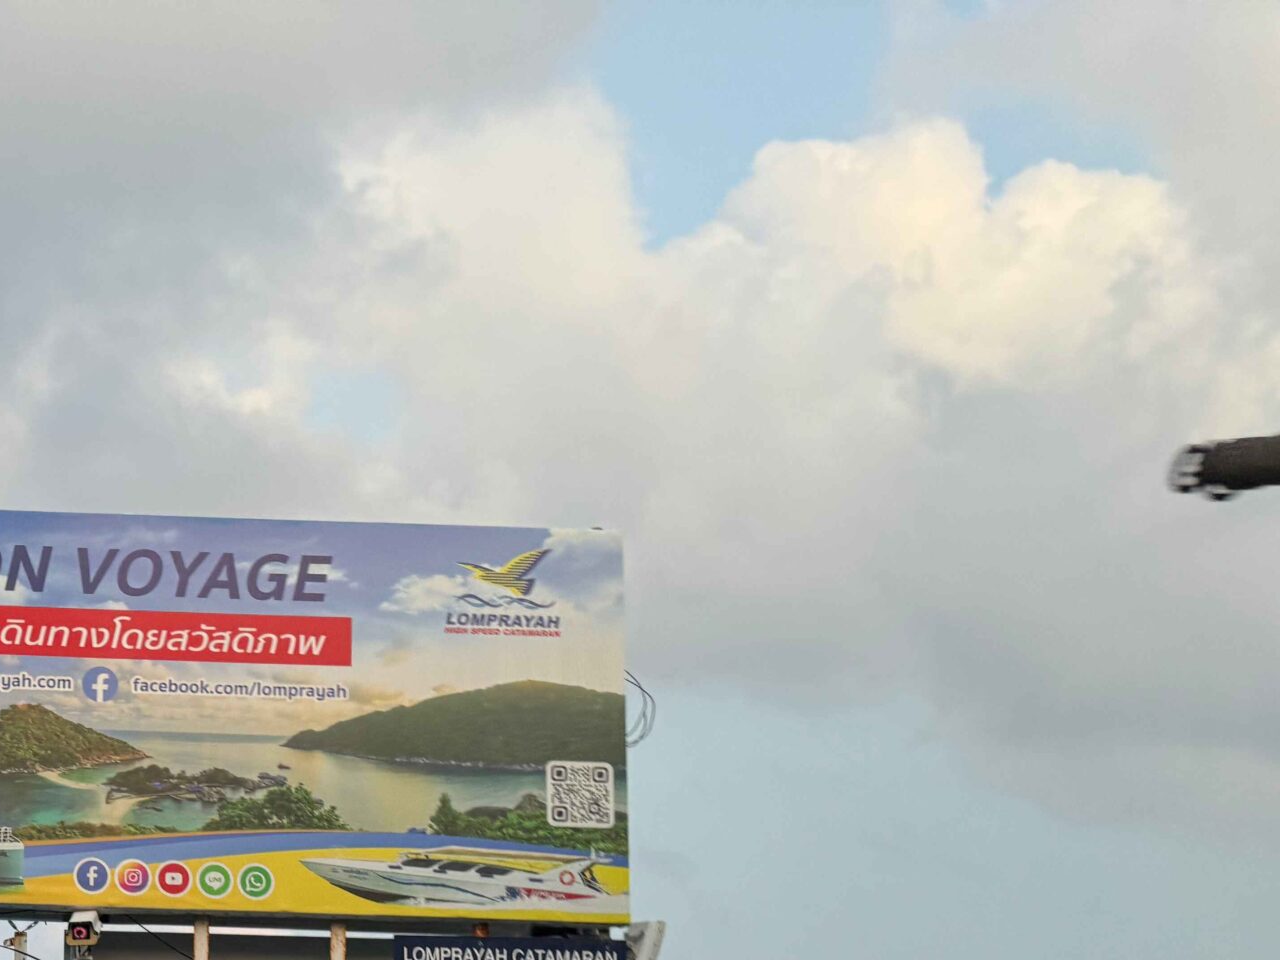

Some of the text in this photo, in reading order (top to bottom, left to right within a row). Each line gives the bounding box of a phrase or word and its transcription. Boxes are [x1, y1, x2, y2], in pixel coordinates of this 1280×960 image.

[76, 546, 334, 602] VOYAGE
[445, 612, 561, 628] LOMPRAYAH
[133, 677, 348, 700] facebook.com/lomprayah
